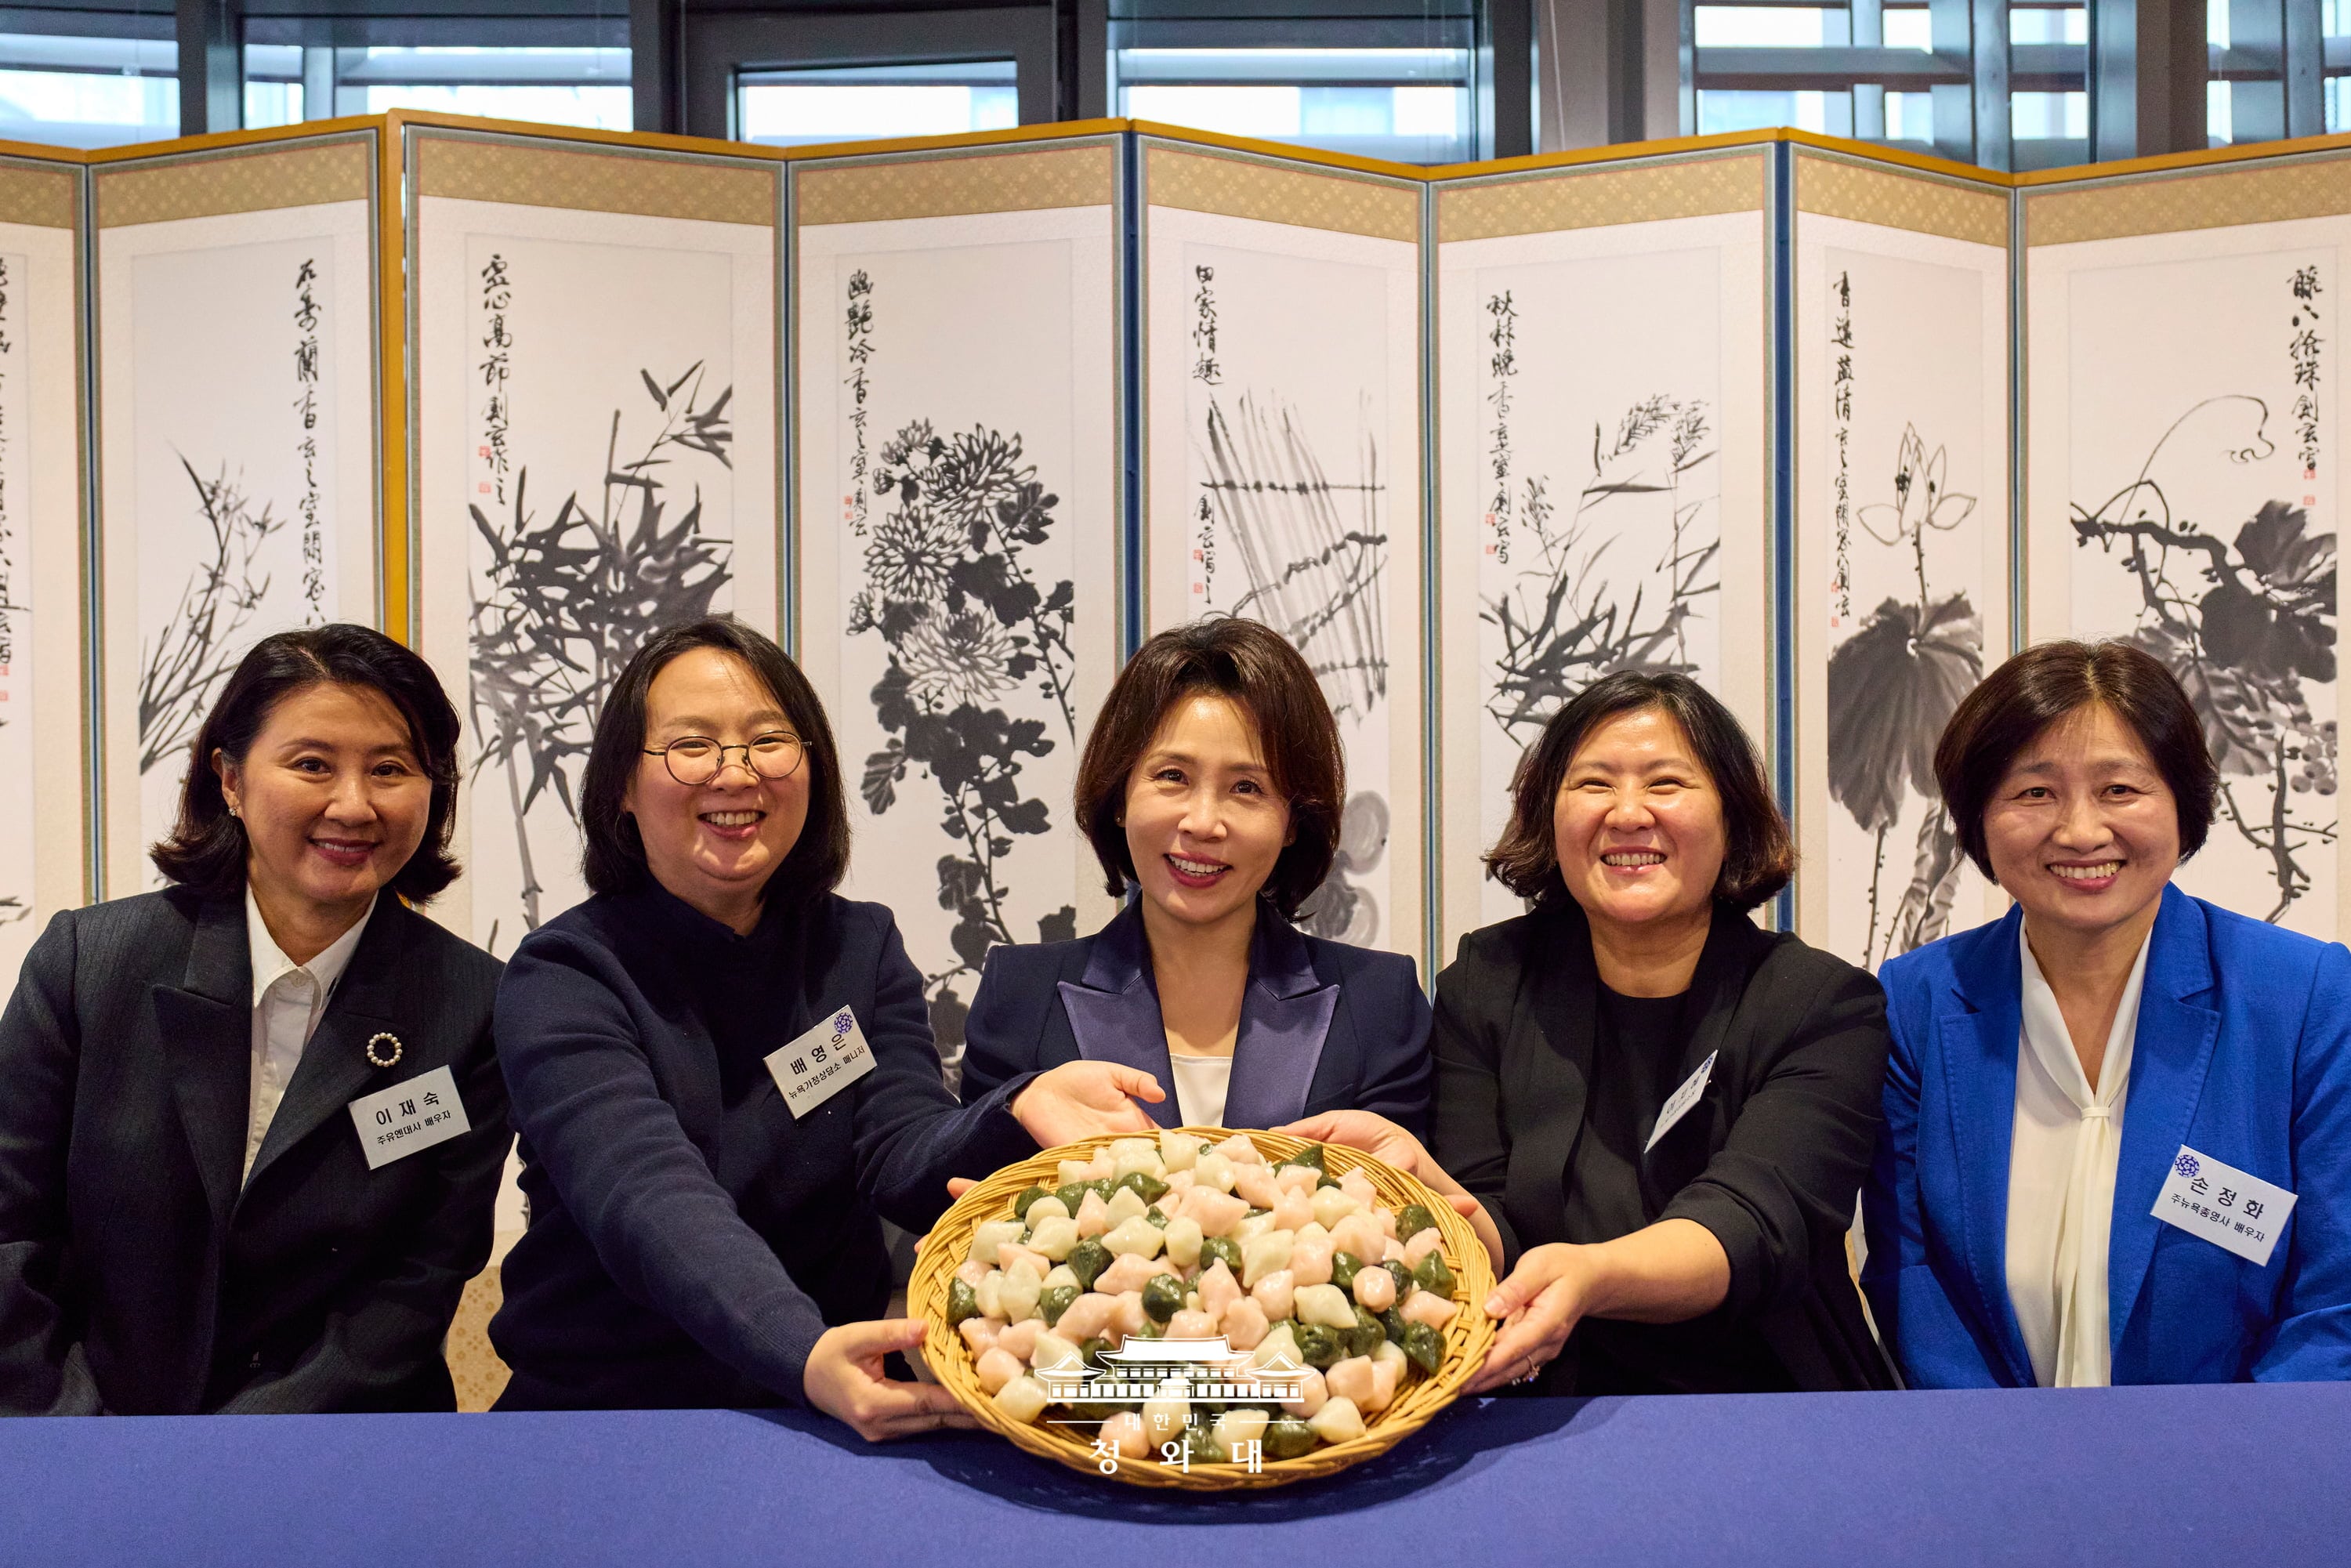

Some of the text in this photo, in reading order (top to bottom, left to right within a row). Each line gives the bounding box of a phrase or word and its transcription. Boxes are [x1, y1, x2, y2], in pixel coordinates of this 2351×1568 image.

[788, 1045, 865, 1099] 뉴욕가정상담소 매니저
[377, 1110, 451, 1145] 주유엔대사 배우자
[2171, 1193, 2265, 1243] 주뉴욕총영사 배우자
